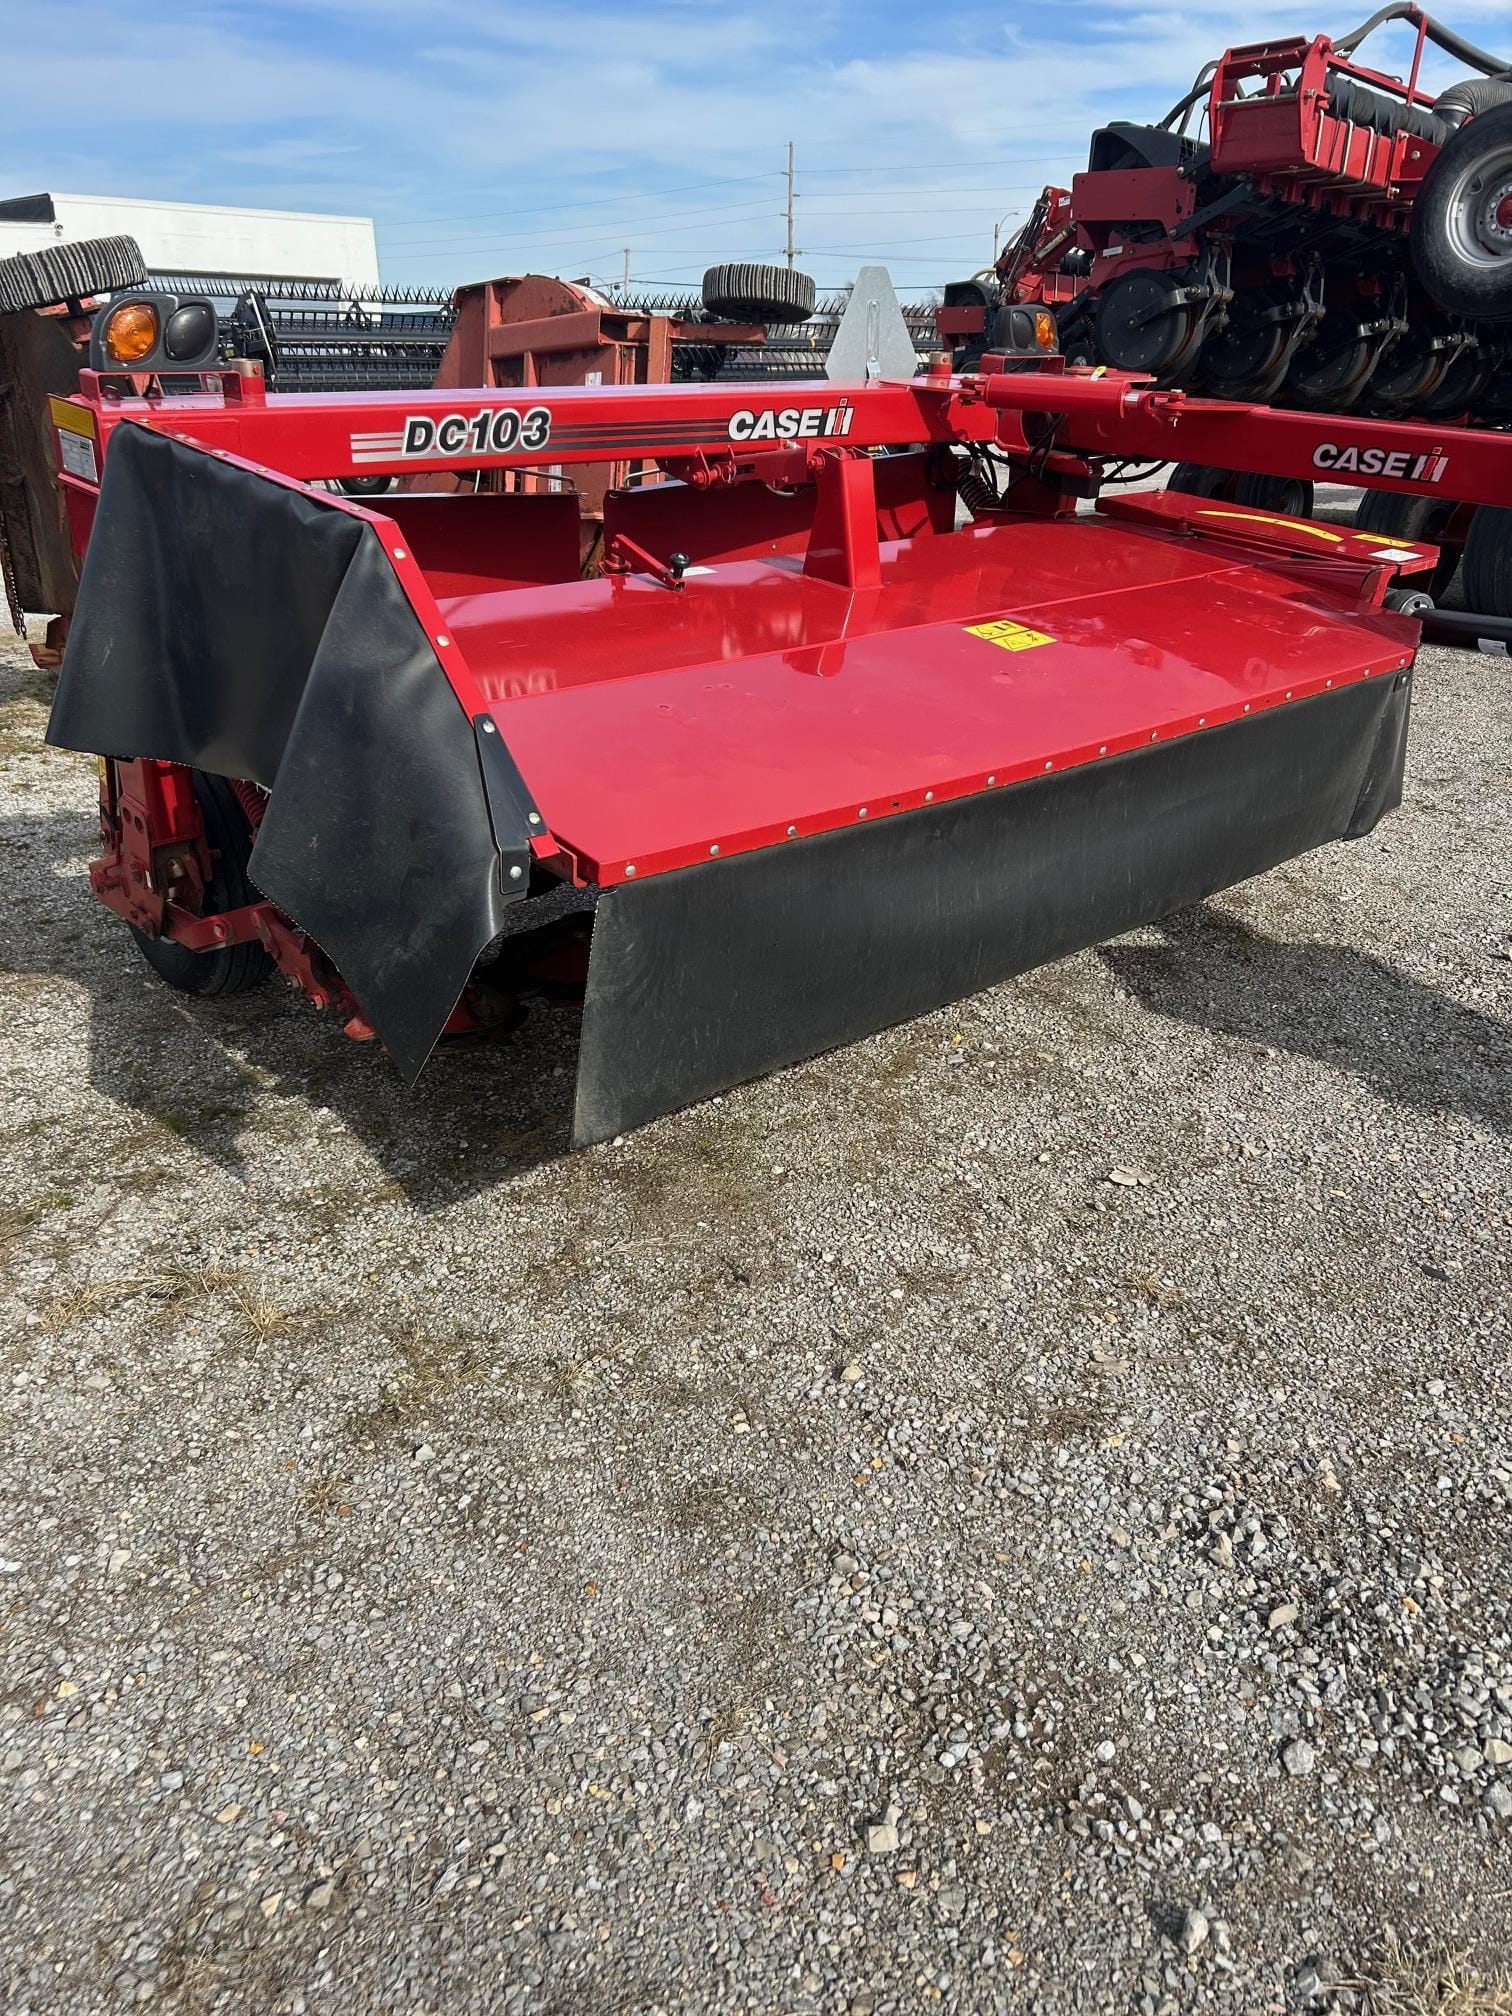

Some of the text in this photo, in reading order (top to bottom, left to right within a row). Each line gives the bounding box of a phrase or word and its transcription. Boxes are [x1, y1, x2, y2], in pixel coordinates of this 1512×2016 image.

[402, 406, 551, 456] DC103
[728, 407, 823, 441] CASE
[1312, 442, 1411, 478] CASE
